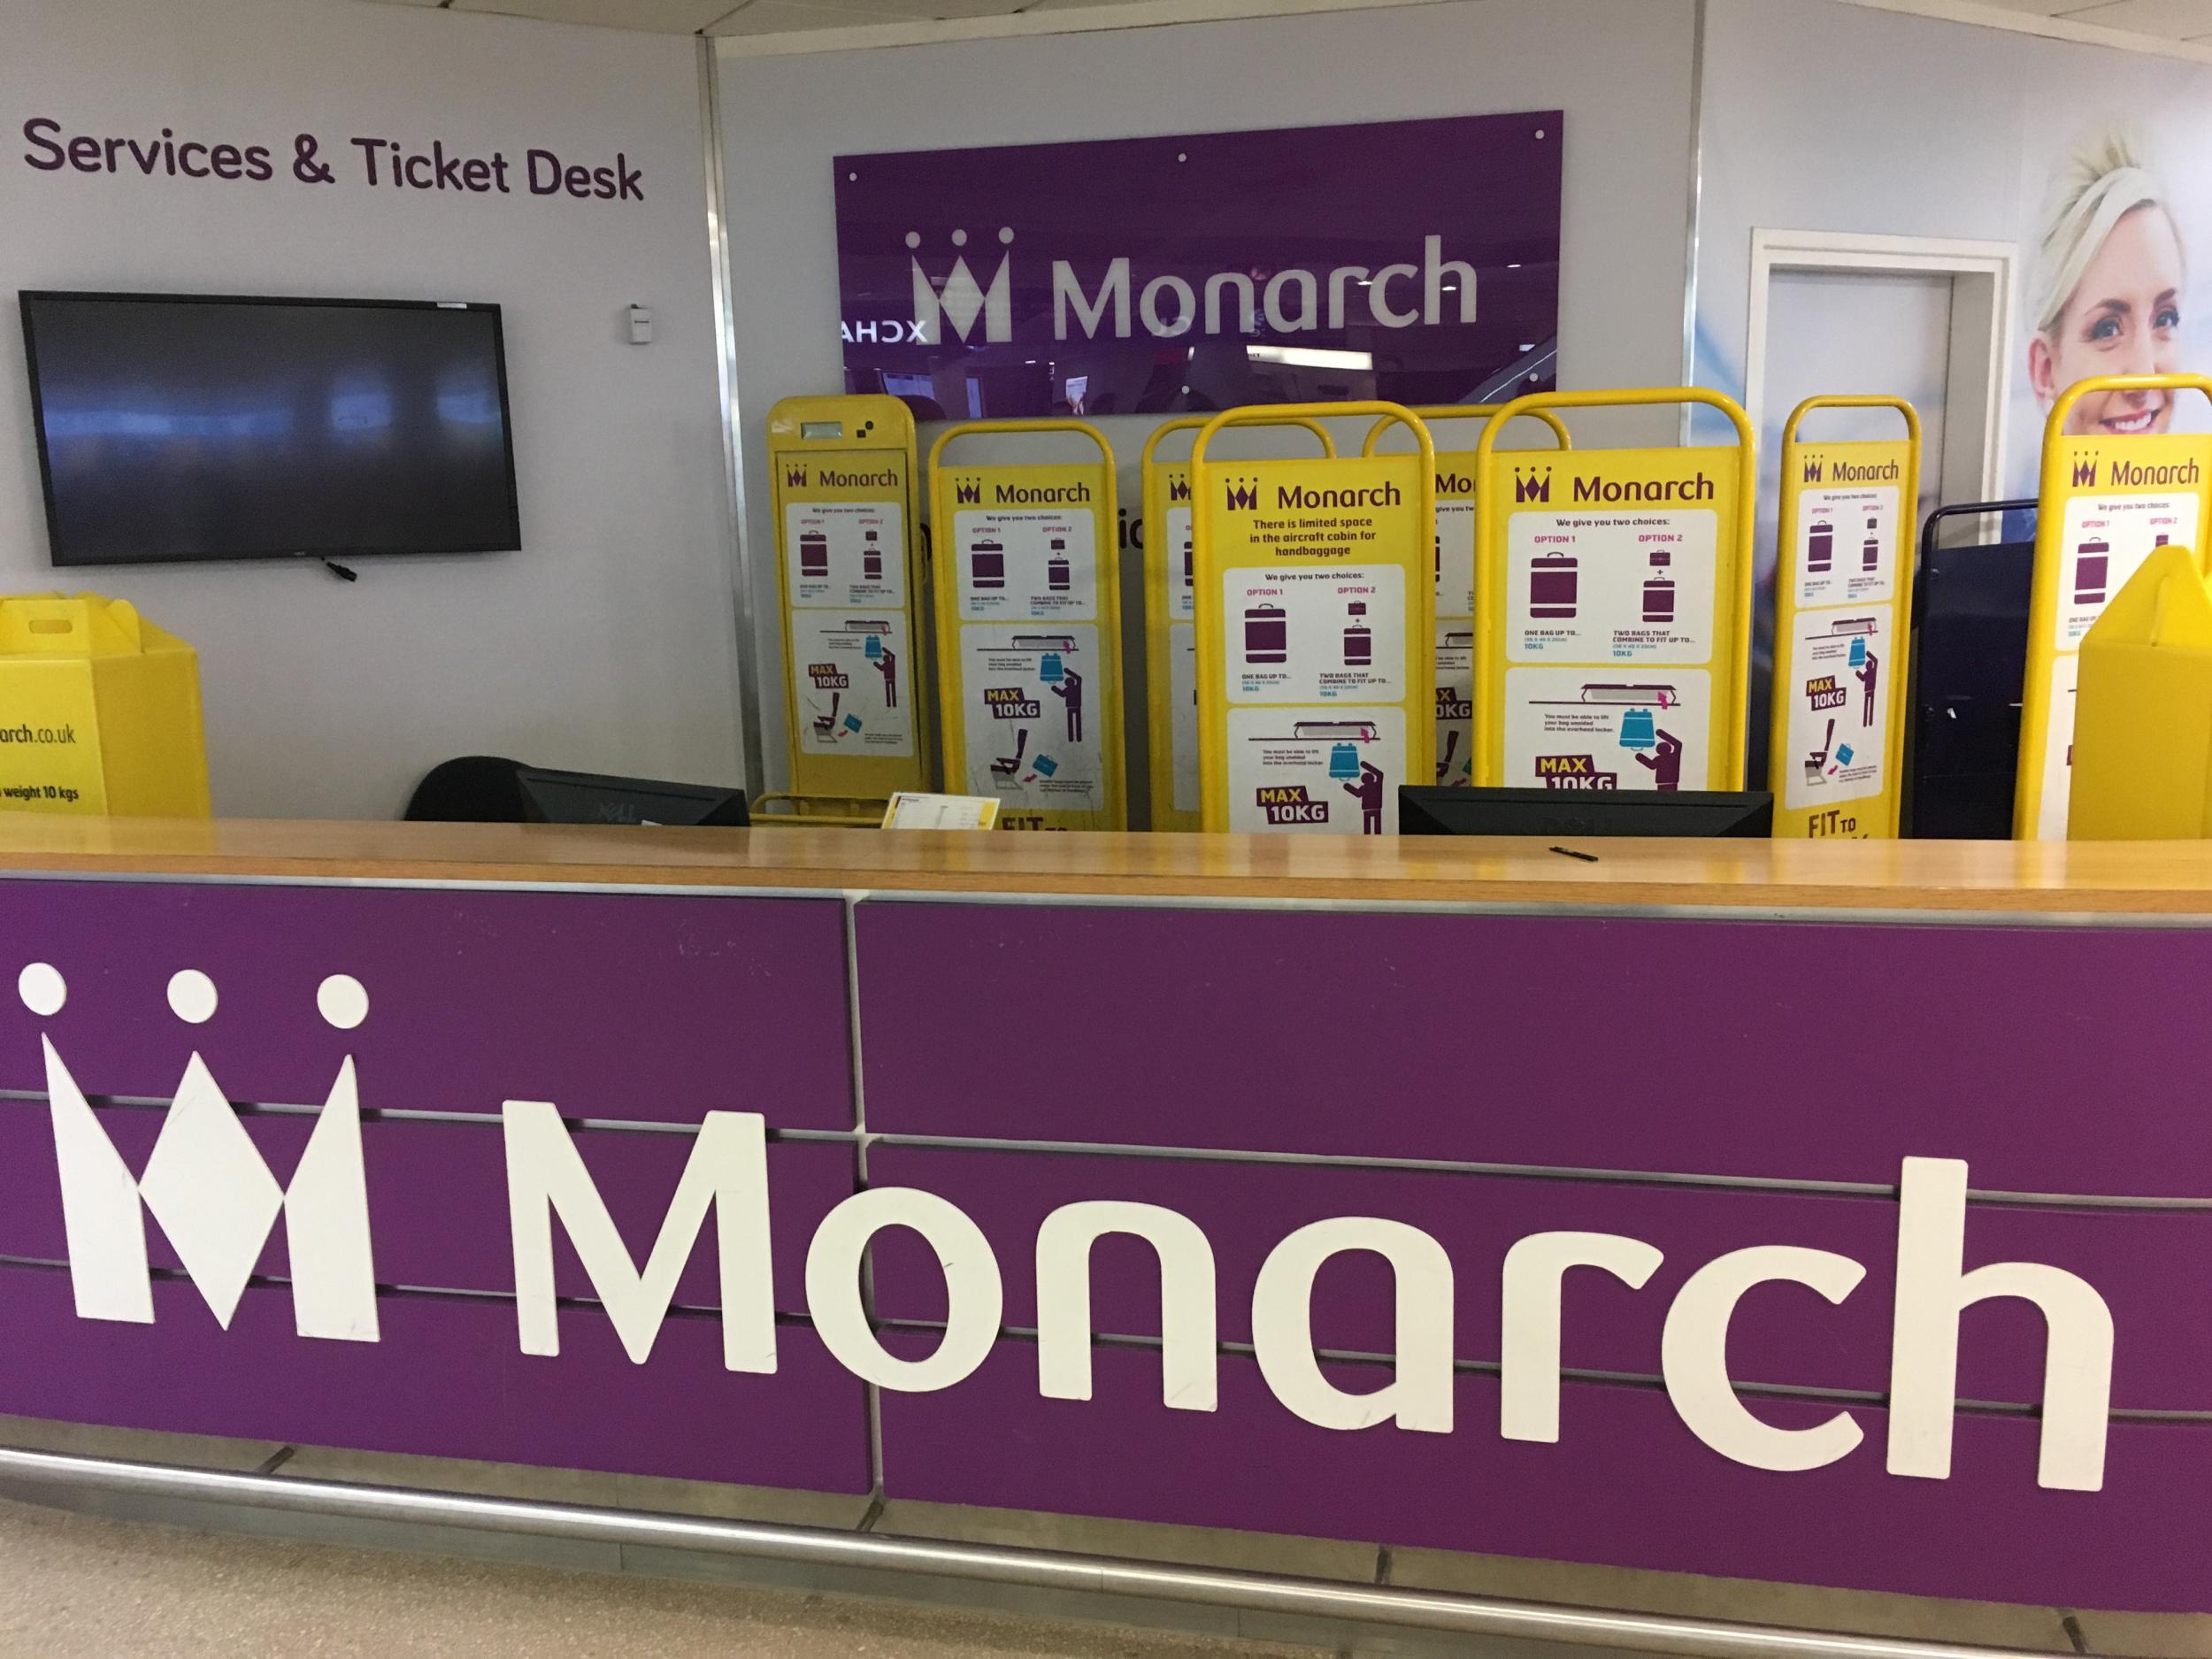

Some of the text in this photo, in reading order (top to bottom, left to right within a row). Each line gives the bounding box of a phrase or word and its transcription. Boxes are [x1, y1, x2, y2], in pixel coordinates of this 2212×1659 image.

[22, 118, 646, 201] Services & Ticket Desk
[1051, 232, 1478, 340] Monarch
[820, 468, 898, 487] Monarch
[1833, 459, 1899, 481] Monarch
[2111, 457, 2199, 486] Monarch
[996, 482, 1090, 503] Monarch
[1277, 480, 1401, 509] Monarch
[1573, 472, 1714, 502] Monarch
[1254, 518, 1372, 529] There is limited space
[1250, 531, 1376, 542] in the aircraft cabin for
[1275, 546, 1351, 558] handbaggage
[811, 665, 833, 674] MAX
[817, 676, 847, 687] 10KG
[1808, 679, 1832, 693] MAX
[987, 689, 1019, 701] MAX
[1813, 690, 1844, 708] 10KG
[996, 703, 1038, 717] 10KG
[1436, 703, 1471, 718] 0KG
[1540, 757, 1587, 773] MAX
[1551, 776, 1613, 789] 10KG
[4, 785, 79, 802] weight 10 kgs
[1260, 788, 1302, 803] MAX
[1271, 805, 1325, 821] 10KG
[1809, 810, 1856, 838] FIT TO
[500, 1098, 2118, 1495] Monarch
